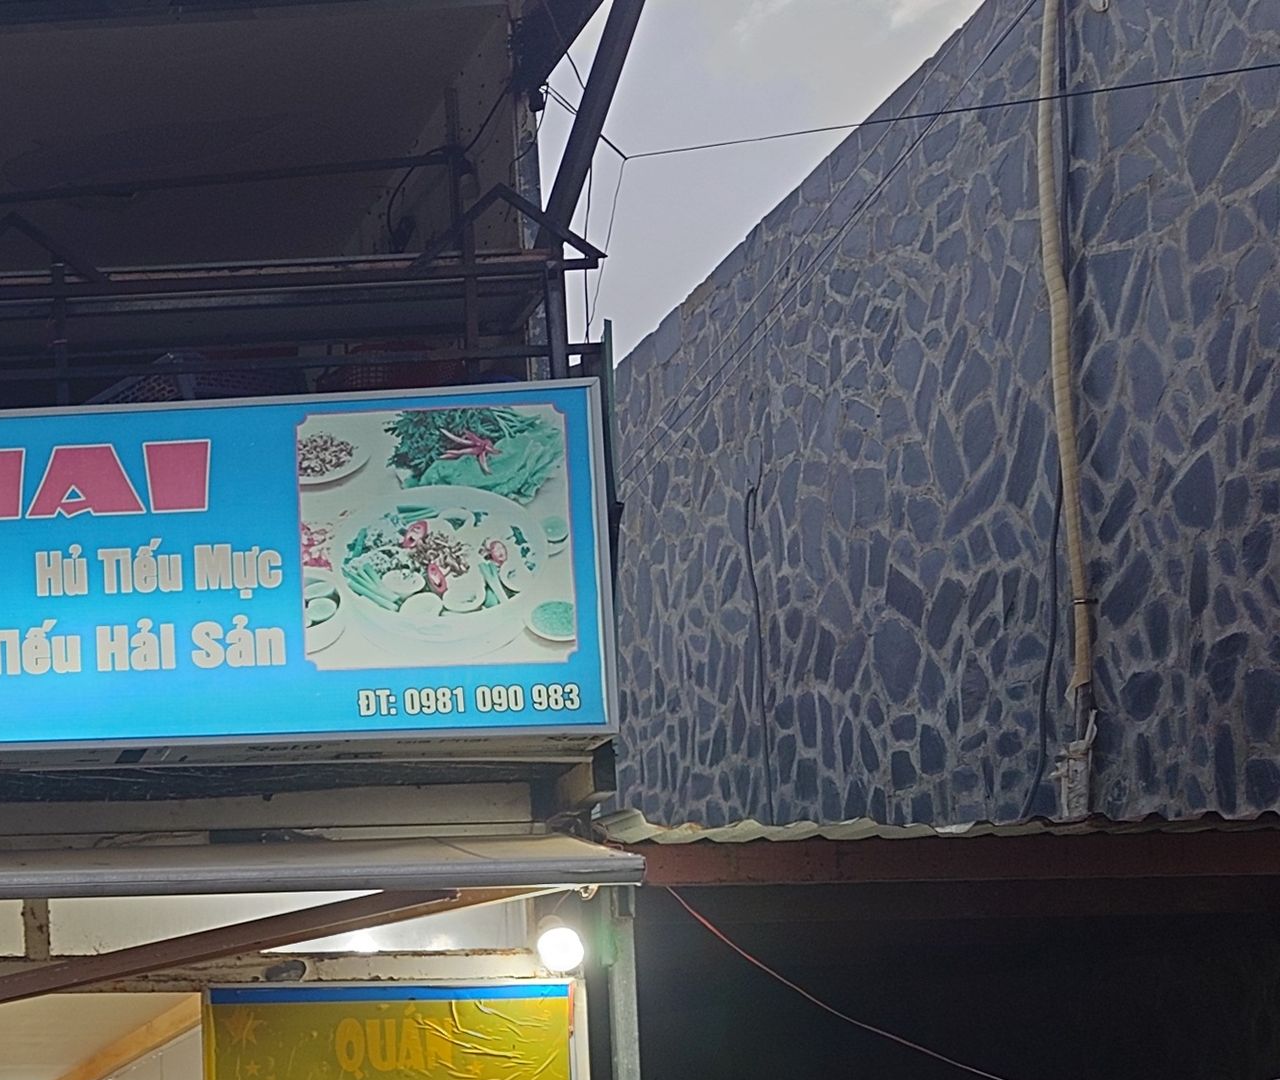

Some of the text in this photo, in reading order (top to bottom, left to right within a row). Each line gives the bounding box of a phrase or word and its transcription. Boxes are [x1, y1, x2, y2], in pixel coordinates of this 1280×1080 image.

[35, 538, 283, 599] Hủ Tiếu Mực
[96, 618, 176, 673] Hải
[191, 614, 287, 668] Sản
[358, 683, 581, 716] ĐT: 0981 090 983
